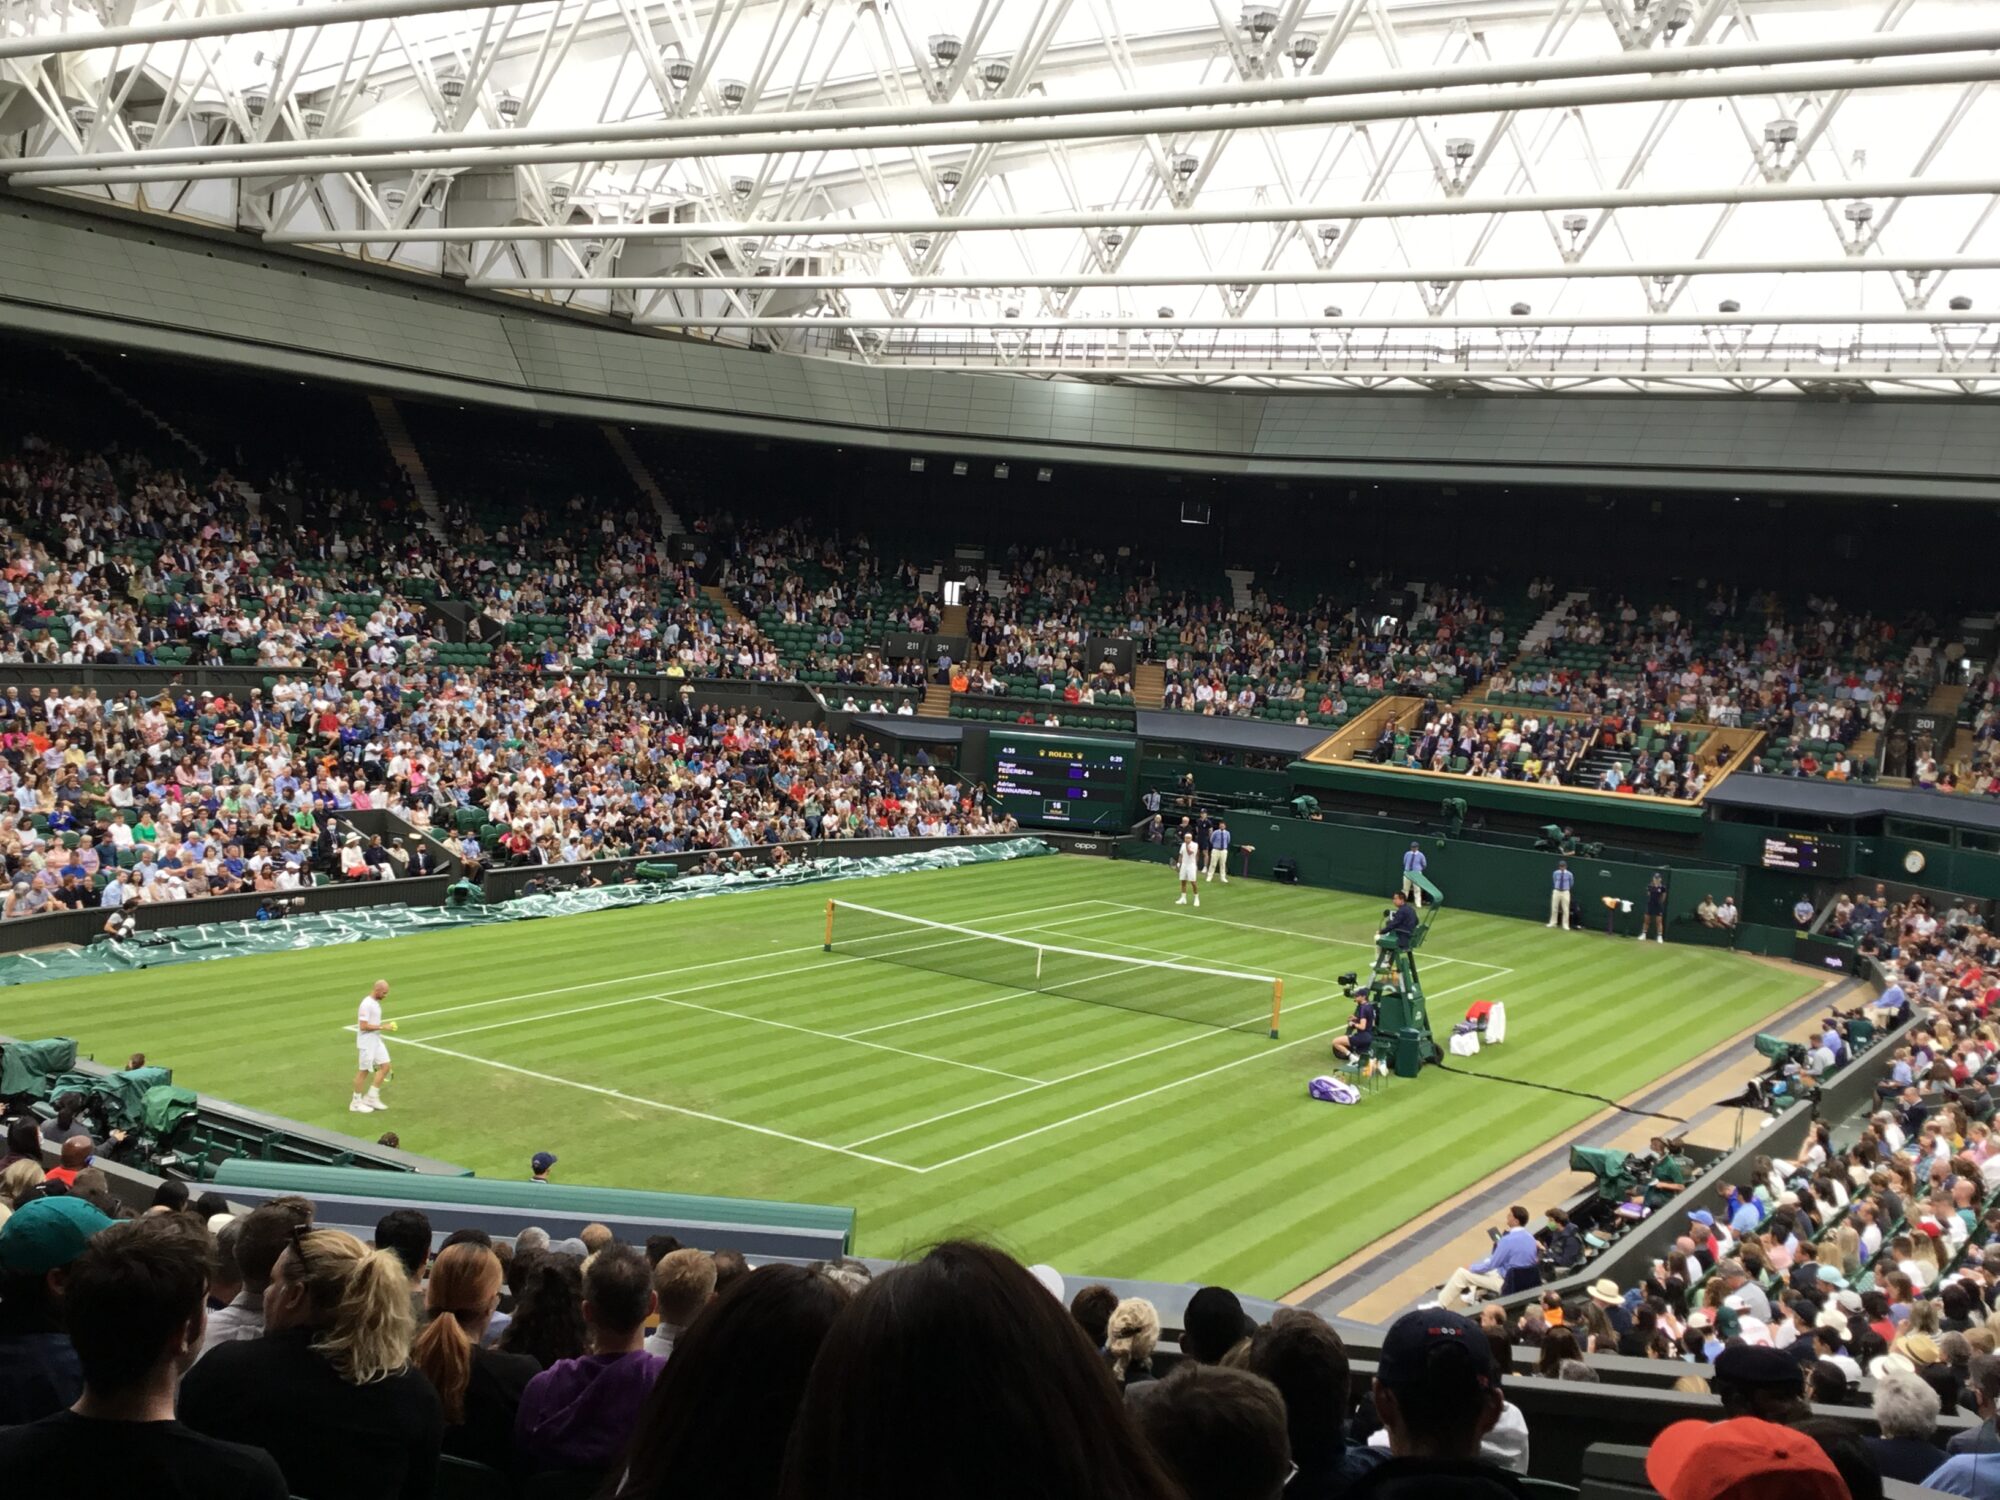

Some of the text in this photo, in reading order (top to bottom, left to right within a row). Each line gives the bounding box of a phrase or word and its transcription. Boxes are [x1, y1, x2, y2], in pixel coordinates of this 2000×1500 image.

[907, 641, 919, 650] 211
[937, 644, 949, 652] 211
[1104, 647, 1118, 656] 212
[1917, 719, 1935, 729] 201
[1048, 751, 1074, 759] ROLEX
[998, 761, 1017, 769] Roger
[998, 767, 1026, 775] FEDERER
[1083, 770, 1090, 778] 4
[996, 787, 1033, 796] MANNARINO
[1082, 790, 1088, 798] 3
[1074, 842, 1097, 850] oppo
